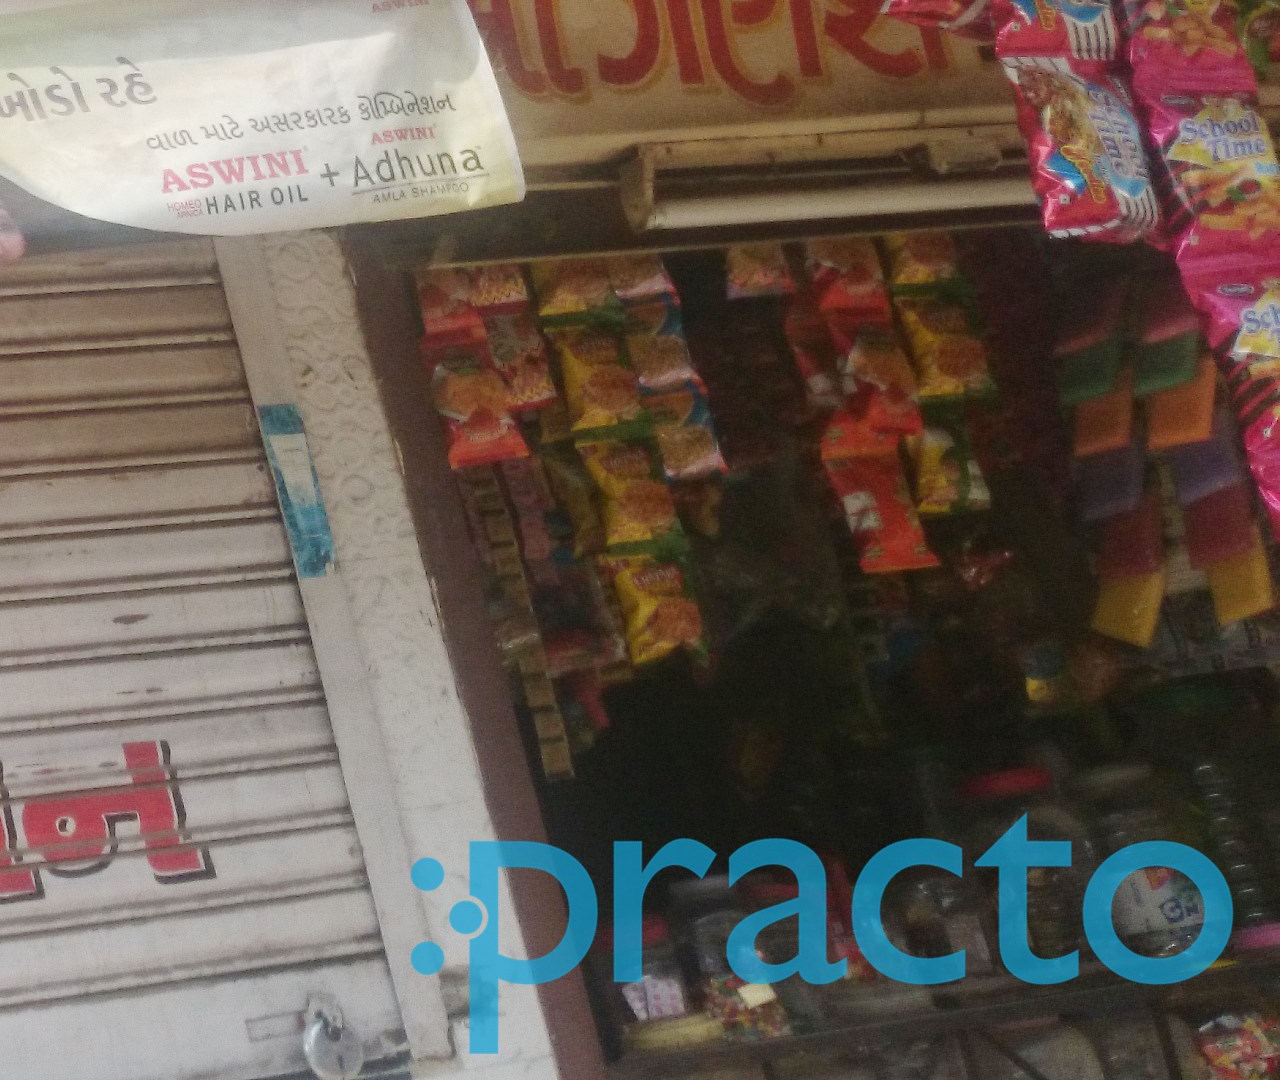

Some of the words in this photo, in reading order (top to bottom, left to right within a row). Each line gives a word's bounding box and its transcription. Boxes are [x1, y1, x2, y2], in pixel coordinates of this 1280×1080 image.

[96, 56, 157, 108] રહે
[146, 130, 198, 151] વાળ
[201, 115, 244, 141] માટે
[371, 126, 436, 146] ASWINI
[1181, 111, 1259, 143] School
[1208, 139, 1266, 162] Time
[162, 149, 310, 194] ASWINI
[352, 146, 484, 188] Adhuna
[205, 188, 264, 216] HAIR
[270, 184, 309, 206] OIL
